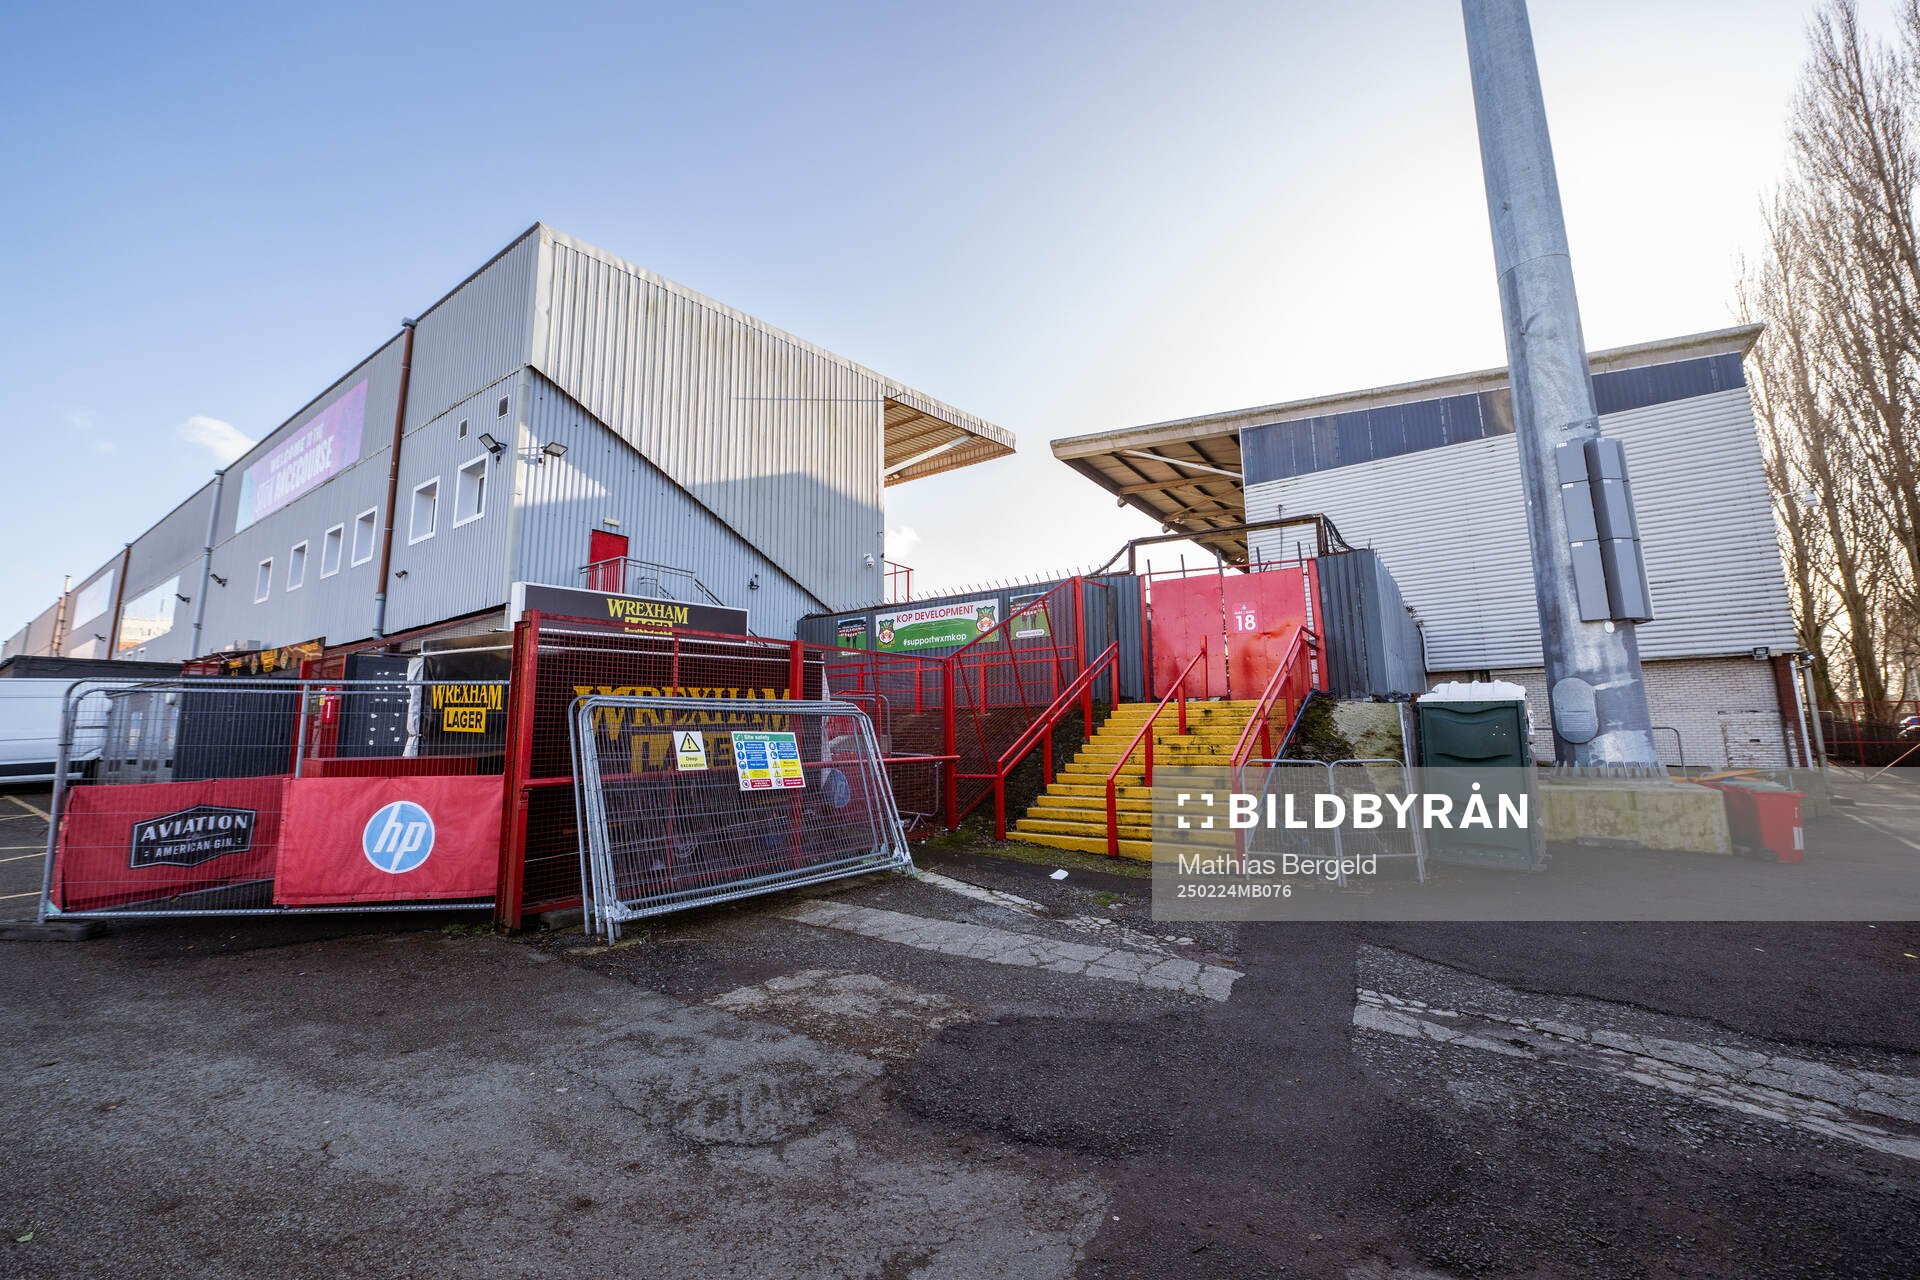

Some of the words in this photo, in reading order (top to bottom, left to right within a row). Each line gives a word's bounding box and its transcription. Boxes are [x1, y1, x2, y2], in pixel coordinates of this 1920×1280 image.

[607, 598, 689, 625] WREXHAM
[896, 614, 913, 623] KOP
[915, 605, 974, 621] DEVELOPMENT
[1235, 614, 1256, 631] 18
[903, 633, 967, 646] #supportwxmkop
[432, 685, 503, 710] WREXHAM
[326, 701, 331, 719] 1
[446, 711, 483, 729] LAGER
[141, 815, 248, 842] AVIATION
[372, 803, 428, 873] hp
[155, 840, 211, 858] AMERICAN
[214, 837, 233, 849] GIN
